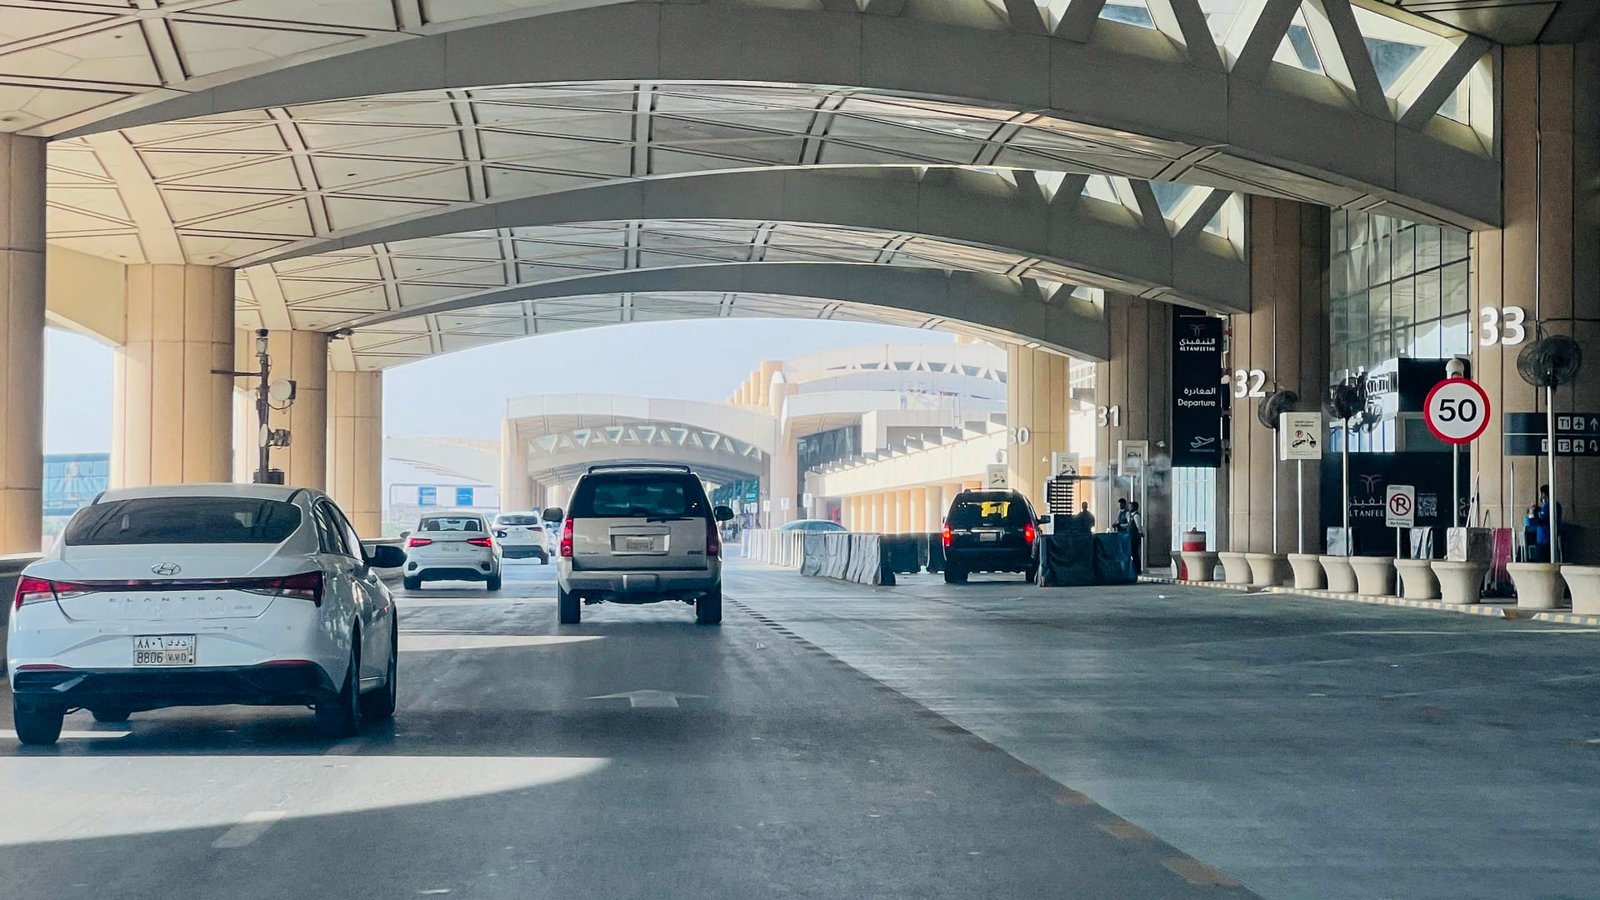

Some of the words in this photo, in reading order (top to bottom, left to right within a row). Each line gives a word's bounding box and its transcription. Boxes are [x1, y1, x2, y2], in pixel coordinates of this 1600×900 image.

[1480, 305, 1525, 346] 33
[1234, 369, 1266, 398] 32
[1184, 387, 1216, 396] المغادرة
[1177, 399, 1216, 408] Departure
[1438, 398, 1477, 422] 50
[1097, 405, 1120, 428] 31
[1559, 418, 1570, 428] T1
[1008, 427, 1030, 445] 30
[1559, 441, 1570, 451] T3
[136, 652, 163, 664] 8806
